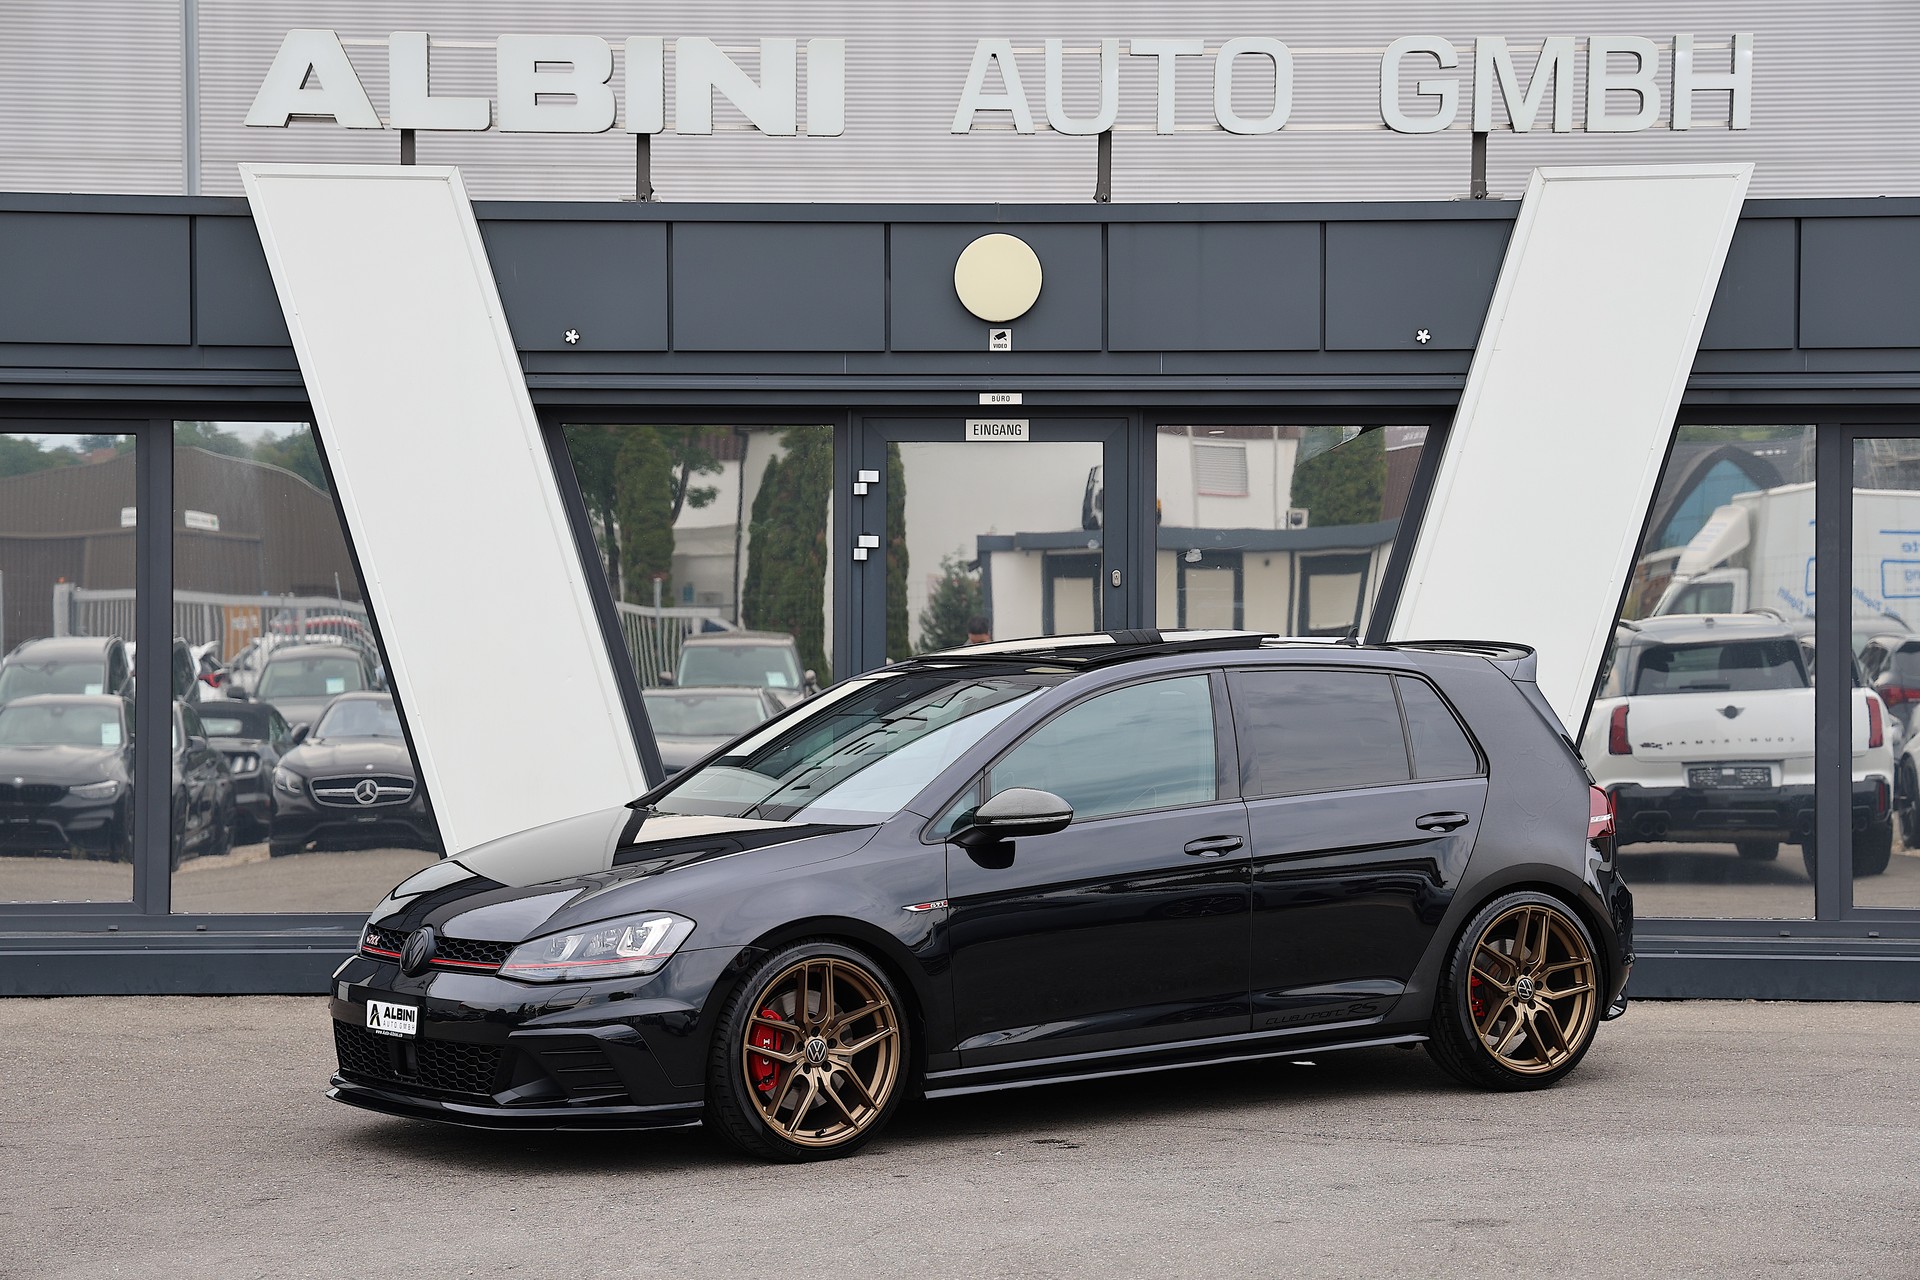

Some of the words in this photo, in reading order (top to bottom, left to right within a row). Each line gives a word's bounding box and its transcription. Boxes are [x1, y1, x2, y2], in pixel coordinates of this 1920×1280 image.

[244, 28, 846, 137] ALBINI
[950, 36, 1293, 137] AUTO
[1379, 32, 1755, 135] GMBH
[991, 394, 1011, 402] BÜRO
[973, 424, 1022, 436] EINGANG
[383, 1006, 416, 1023] ALBINI
[383, 1020, 397, 1029] AUTO
